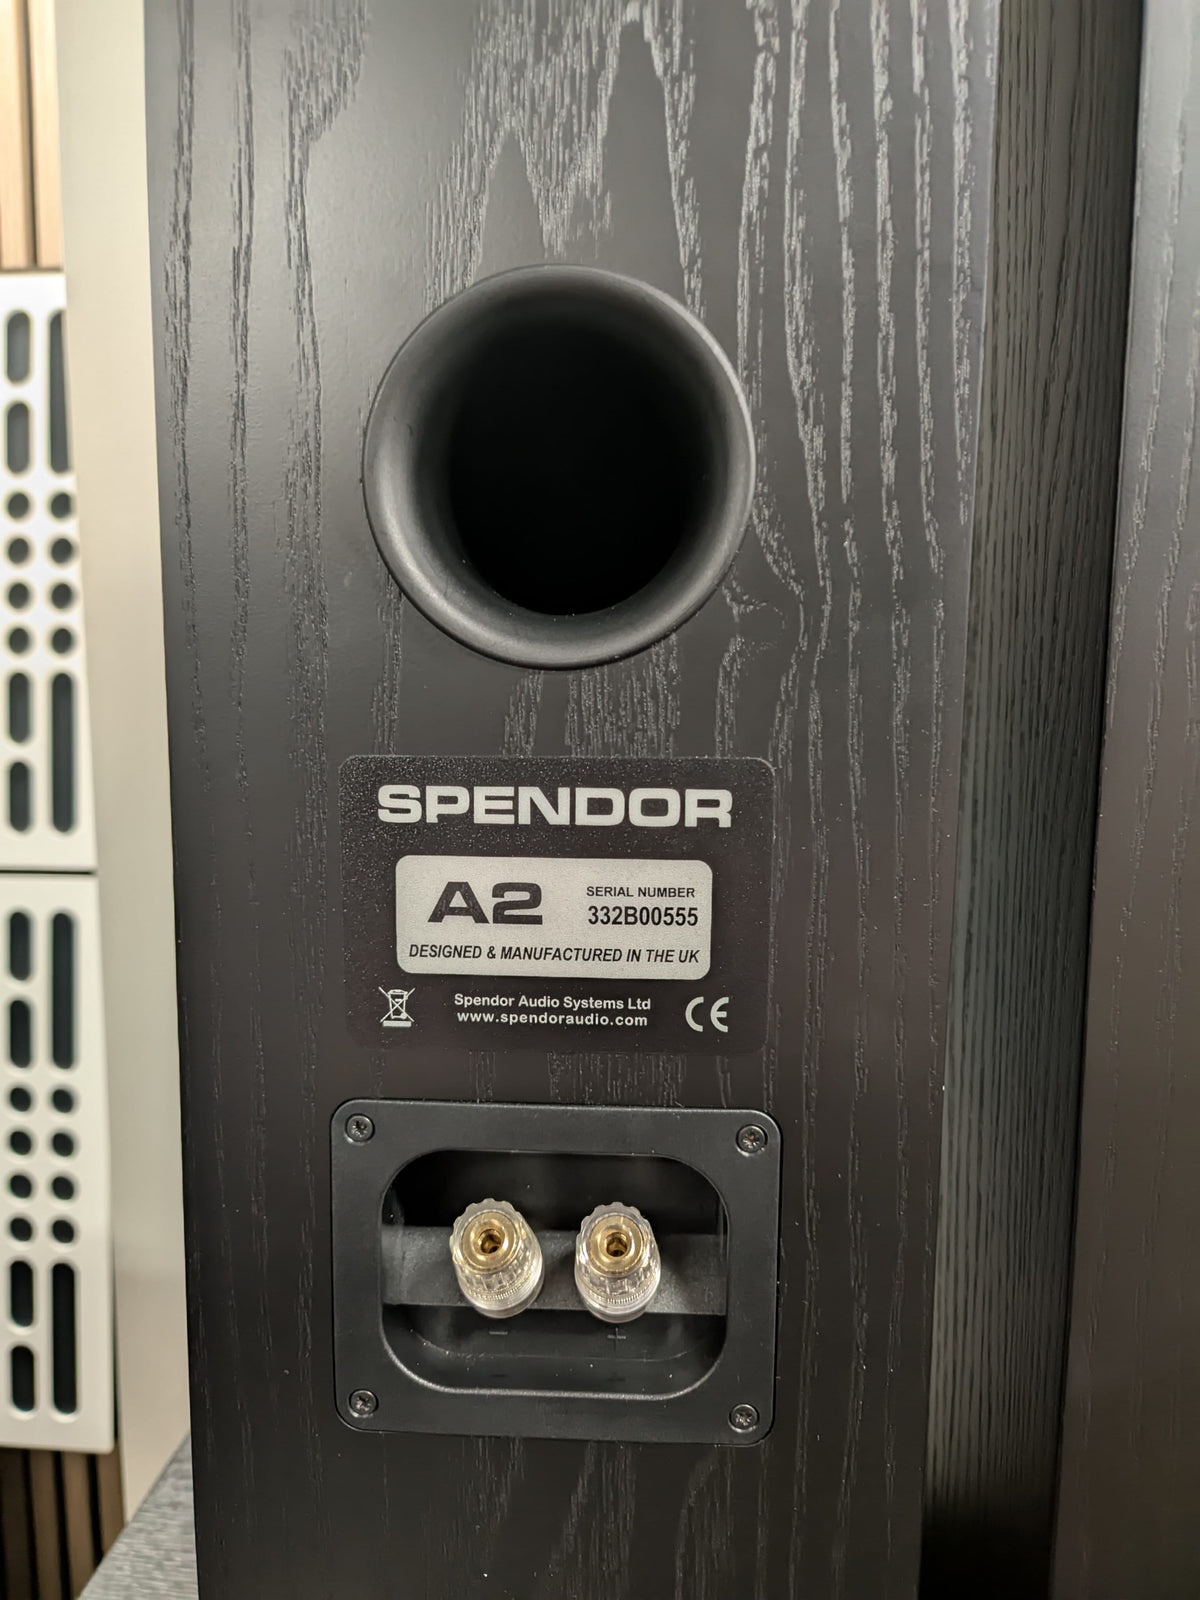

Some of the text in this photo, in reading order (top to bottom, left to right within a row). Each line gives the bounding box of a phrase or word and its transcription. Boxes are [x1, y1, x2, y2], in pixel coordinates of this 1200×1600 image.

[378, 784, 732, 828] SPENDOR
[586, 885, 696, 899] SERIAL NUMBER
[427, 881, 543, 925] A2
[588, 905, 699, 927] 332B00555
[408, 944, 700, 964] DESIGNED & MANUFACTURED IN THE UK
[454, 993, 651, 1011] Spendor Audio Systems Ltd
[457, 1010, 648, 1027] www.spendoraudio.com
